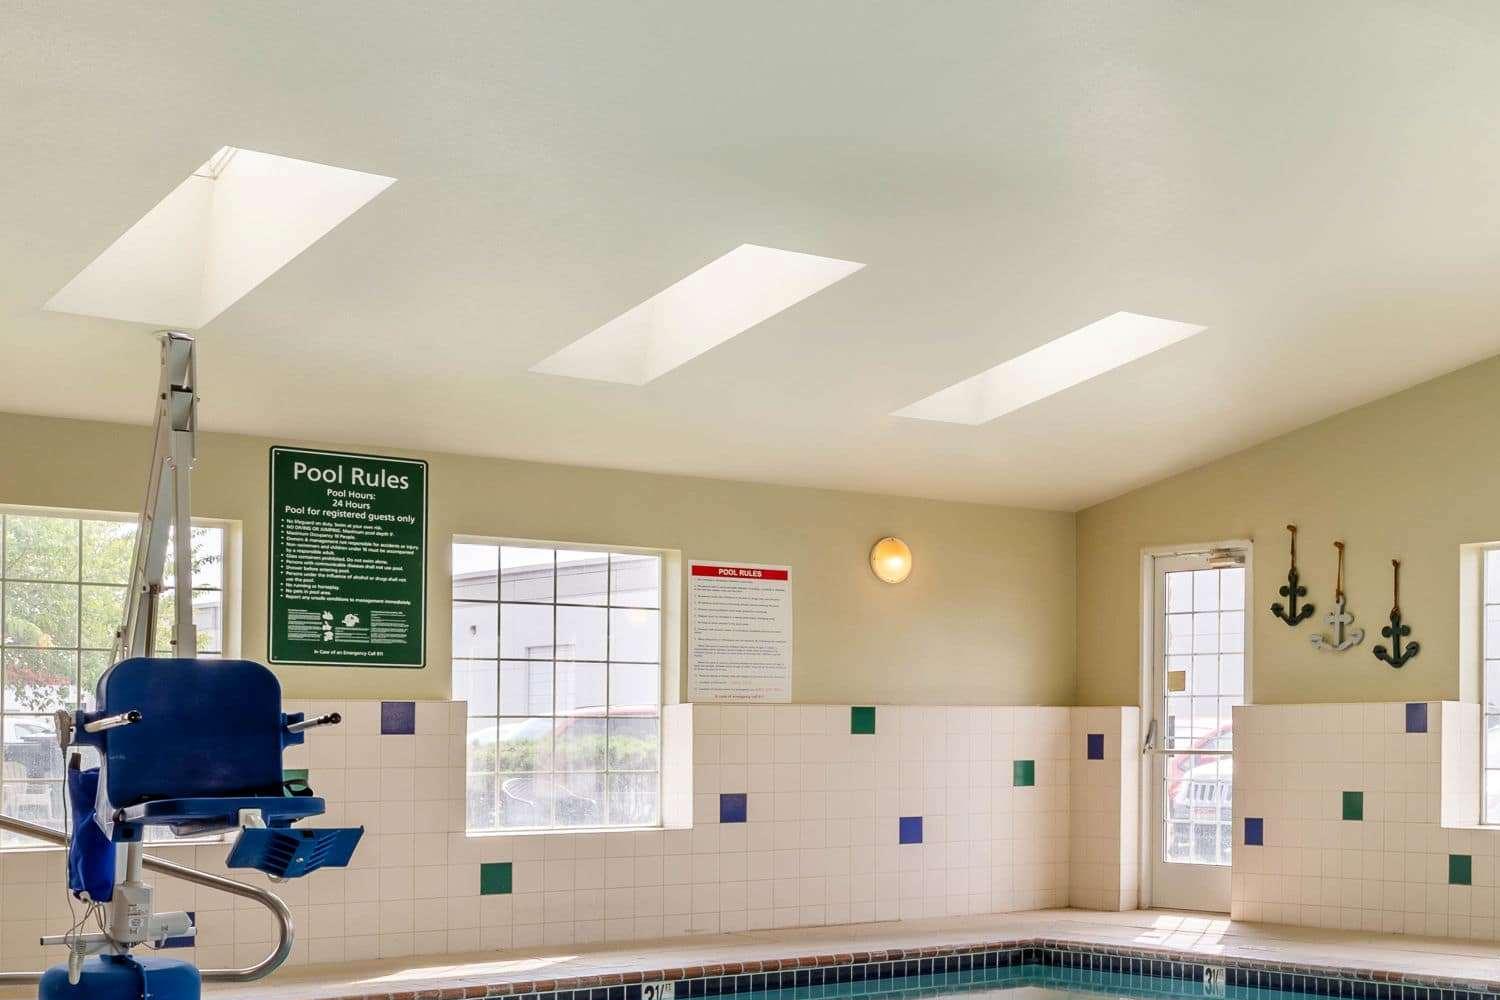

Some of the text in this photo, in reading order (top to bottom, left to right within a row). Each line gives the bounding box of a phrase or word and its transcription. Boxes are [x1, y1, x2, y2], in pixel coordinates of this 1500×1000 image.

[293, 462, 409, 490] Pool Rules
[327, 489, 376, 500] Pool Hours:
[332, 499, 370, 510] 24 Hours
[285, 506, 415, 524] Pool for registered guests only
[739, 569, 762, 577] RULES
